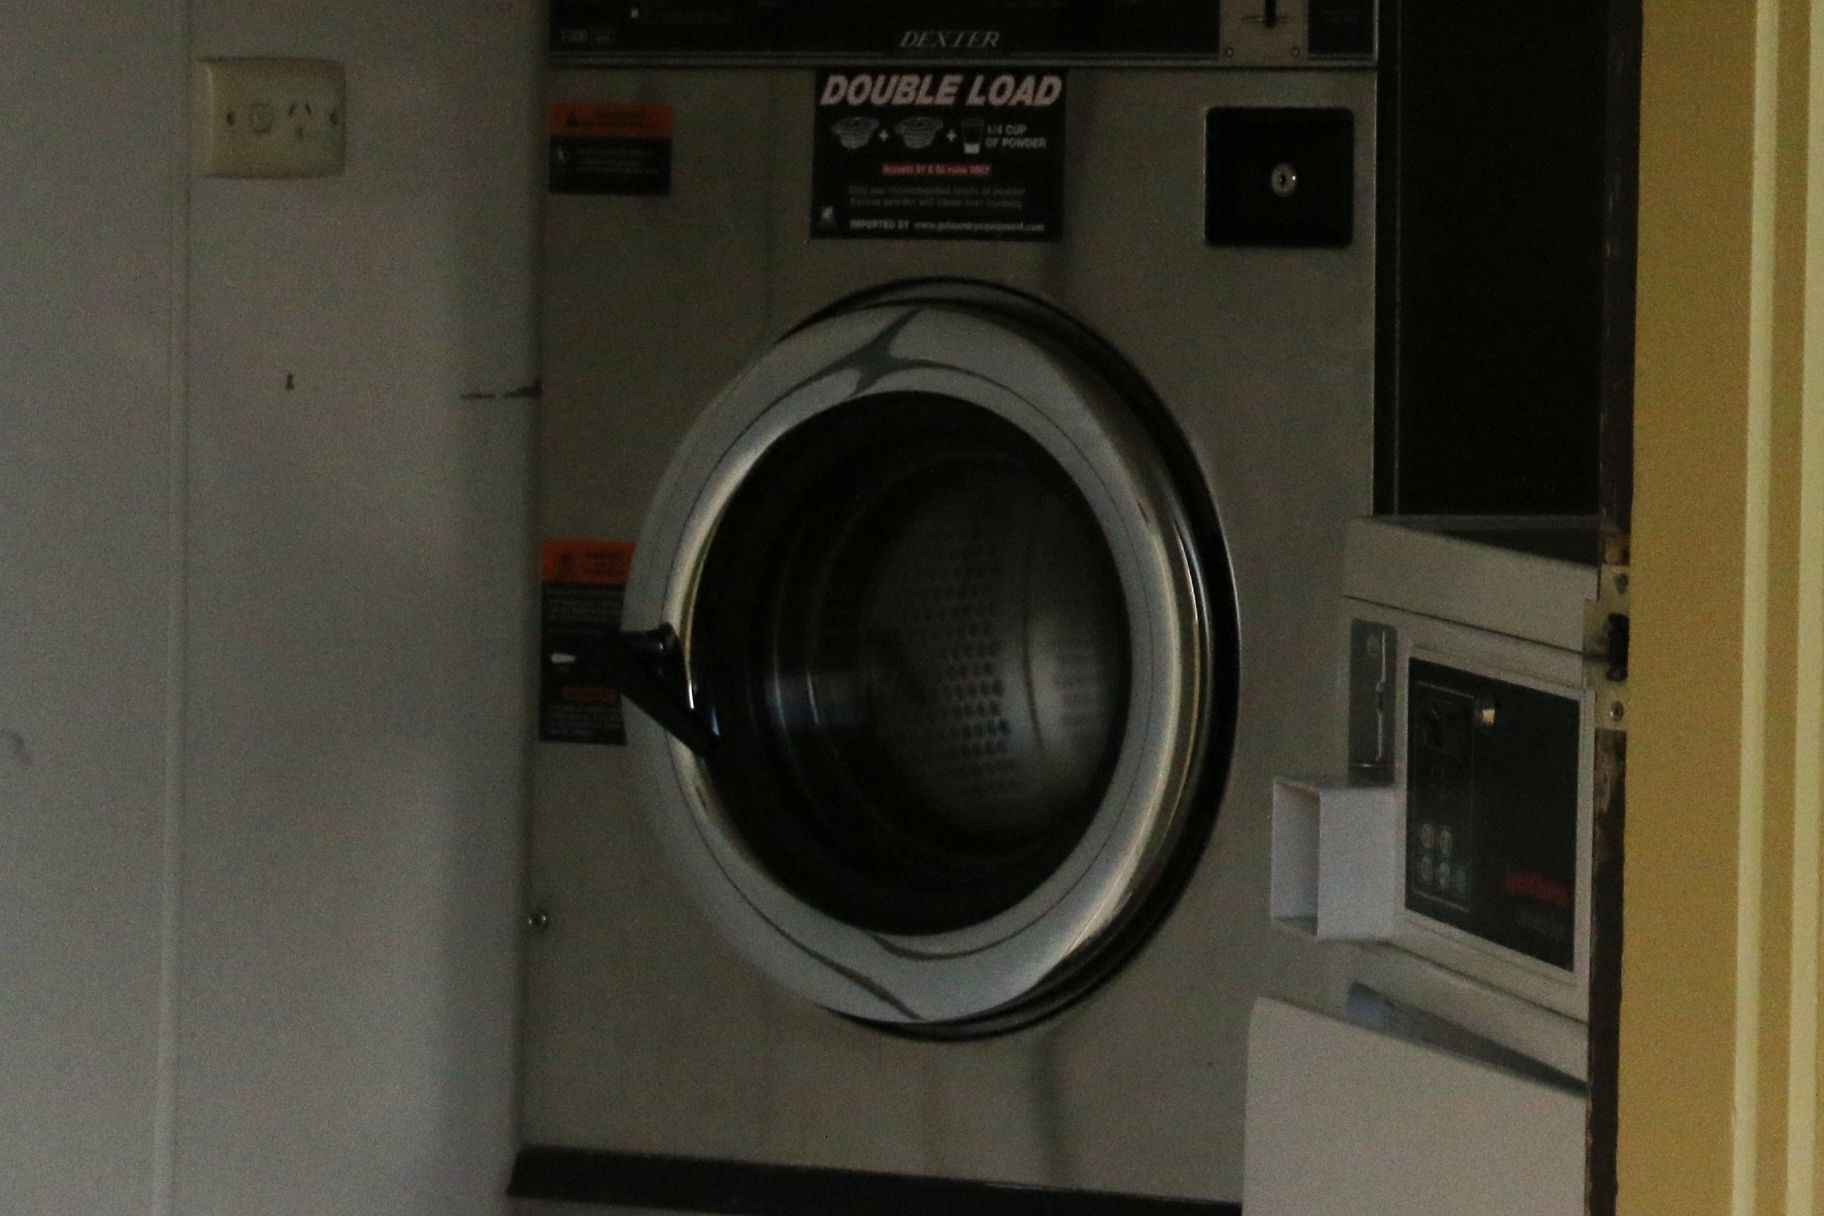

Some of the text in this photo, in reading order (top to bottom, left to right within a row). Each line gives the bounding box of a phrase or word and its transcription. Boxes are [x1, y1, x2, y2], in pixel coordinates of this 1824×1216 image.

[899, 30, 1001, 49] DEXTER
[820, 73, 1063, 107] DOUBLE LOAD
[1005, 124, 1028, 136] CUP
[1002, 137, 1047, 150] POWDER
[850, 218, 896, 230] IMPORTED
